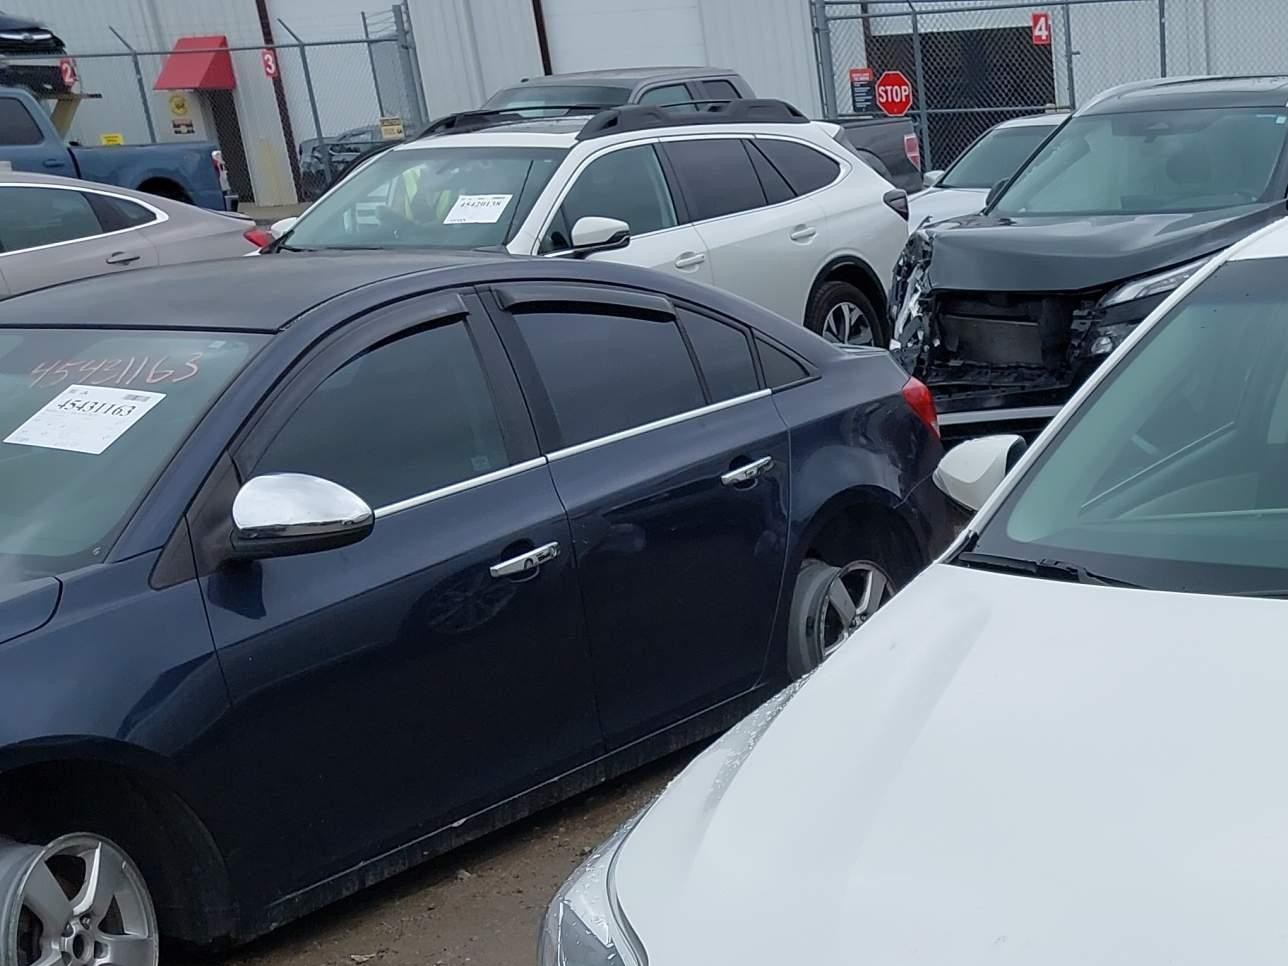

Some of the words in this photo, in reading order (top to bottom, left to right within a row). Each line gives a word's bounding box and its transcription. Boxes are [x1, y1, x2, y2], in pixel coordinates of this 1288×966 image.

[1035, 17, 1048, 40] 4
[62, 62, 74, 84] 2
[264, 54, 276, 75] 3
[878, 86, 910, 103] STOP
[30, 352, 202, 387] 45431163
[57, 399, 136, 417] 45431163
